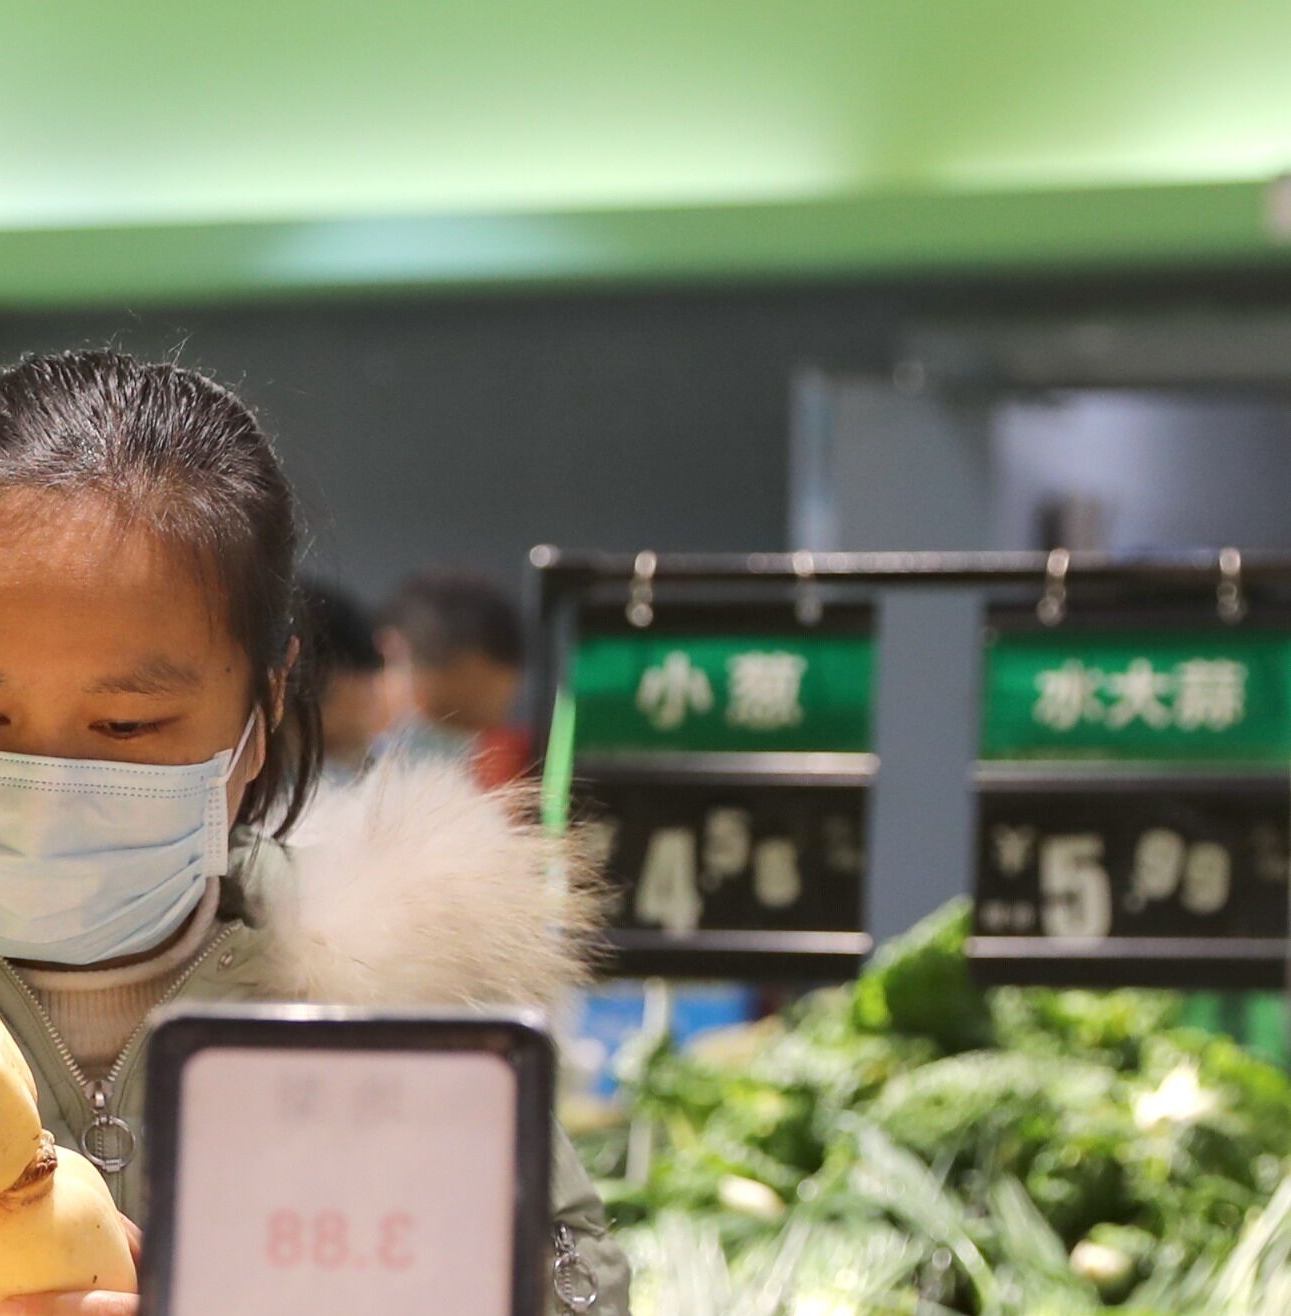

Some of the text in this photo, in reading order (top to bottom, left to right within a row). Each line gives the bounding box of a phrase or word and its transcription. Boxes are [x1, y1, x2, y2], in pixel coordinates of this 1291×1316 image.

[635, 650, 808, 730] 小葱
[1033, 657, 1247, 731] 水大蒜
